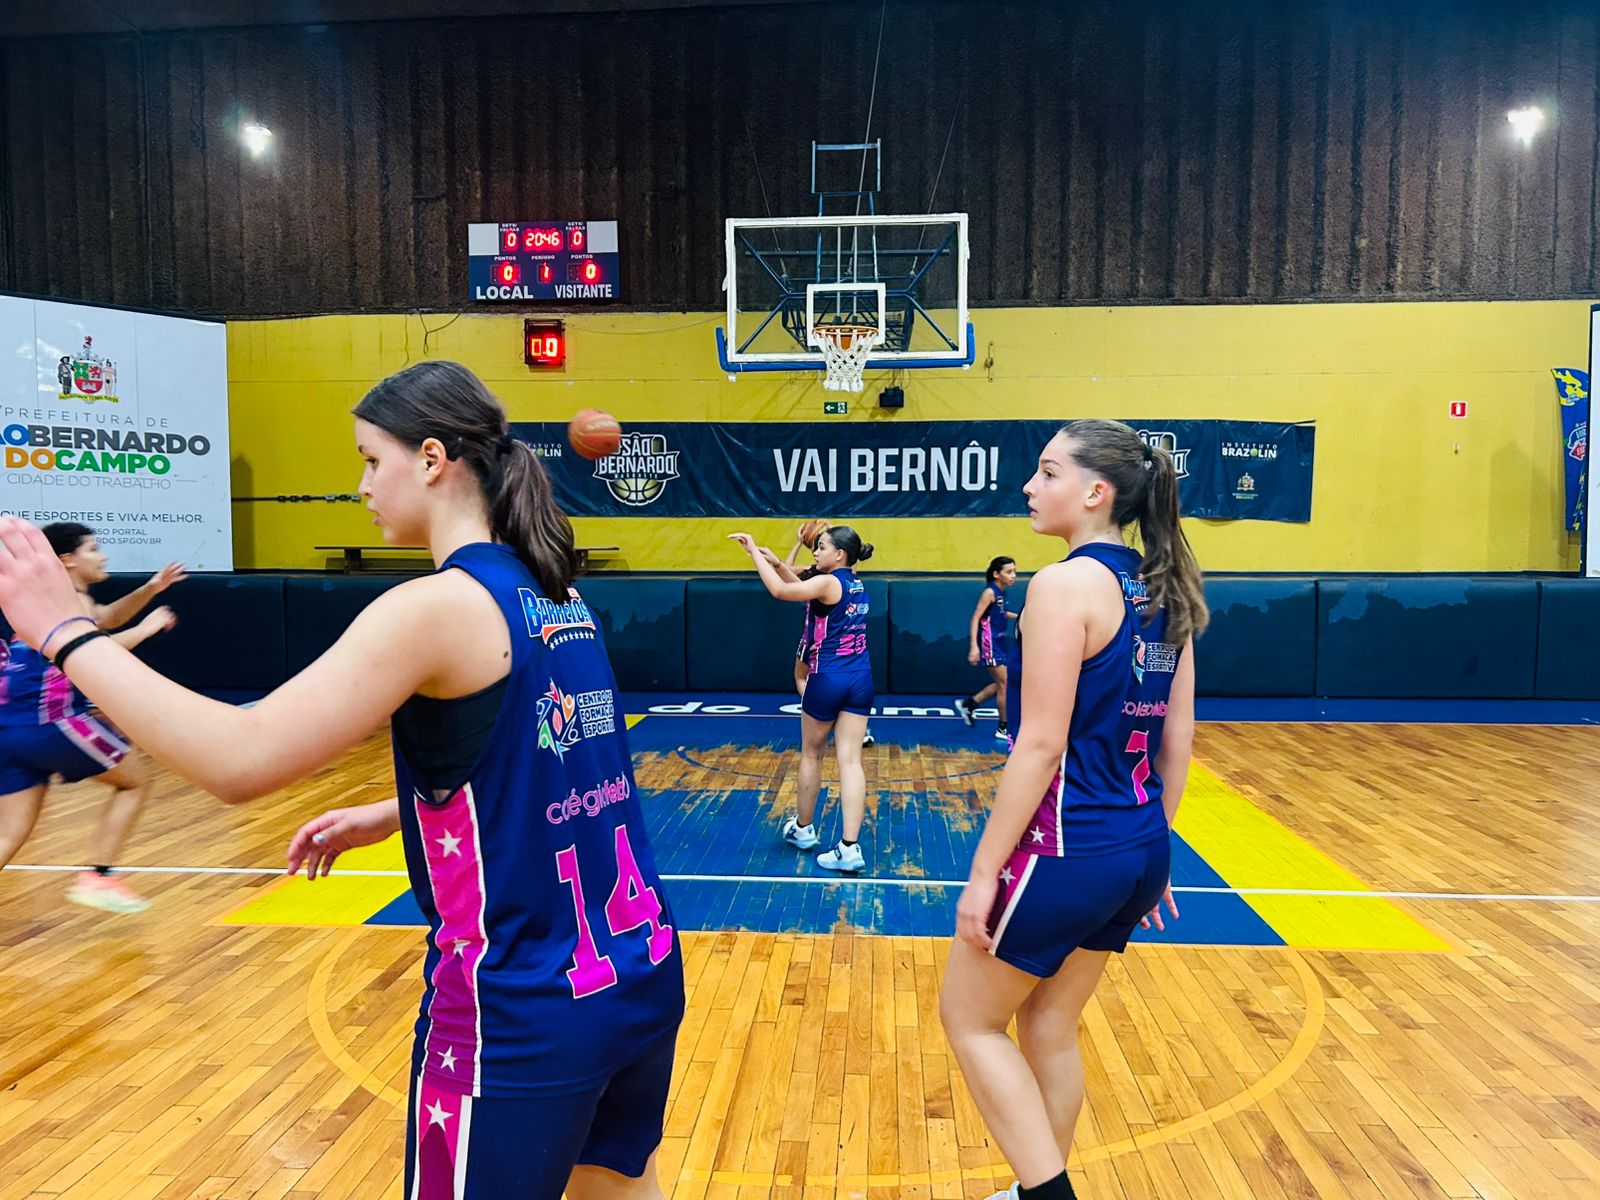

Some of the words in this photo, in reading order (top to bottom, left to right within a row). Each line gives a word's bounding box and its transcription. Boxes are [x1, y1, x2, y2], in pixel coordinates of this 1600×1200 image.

[507, 232, 517, 247] 0
[573, 230, 583, 246] 0
[475, 285, 534, 300] LOCAL
[554, 284, 613, 299] VISITANTE
[4, 407, 134, 426] PREFEITURA
[146, 417, 168, 428] DE
[621, 435, 652, 456] SÃO
[1221, 441, 1278, 450] INSTITUTO
[598, 455, 675, 475] BERNARDO
[772, 448, 838, 492] VAI
[850, 439, 1000, 492] BERNÔ!
[7, 472, 65, 486] CIDADE
[68, 475, 91, 487] DO
[93, 476, 171, 490] TRABALHO
[34, 510, 103, 522] ESPORTES
[107, 512, 115, 522] E
[118, 512, 149, 522] VIVA
[112, 528, 148, 536] PORTAL
[555, 823, 673, 999] 14
